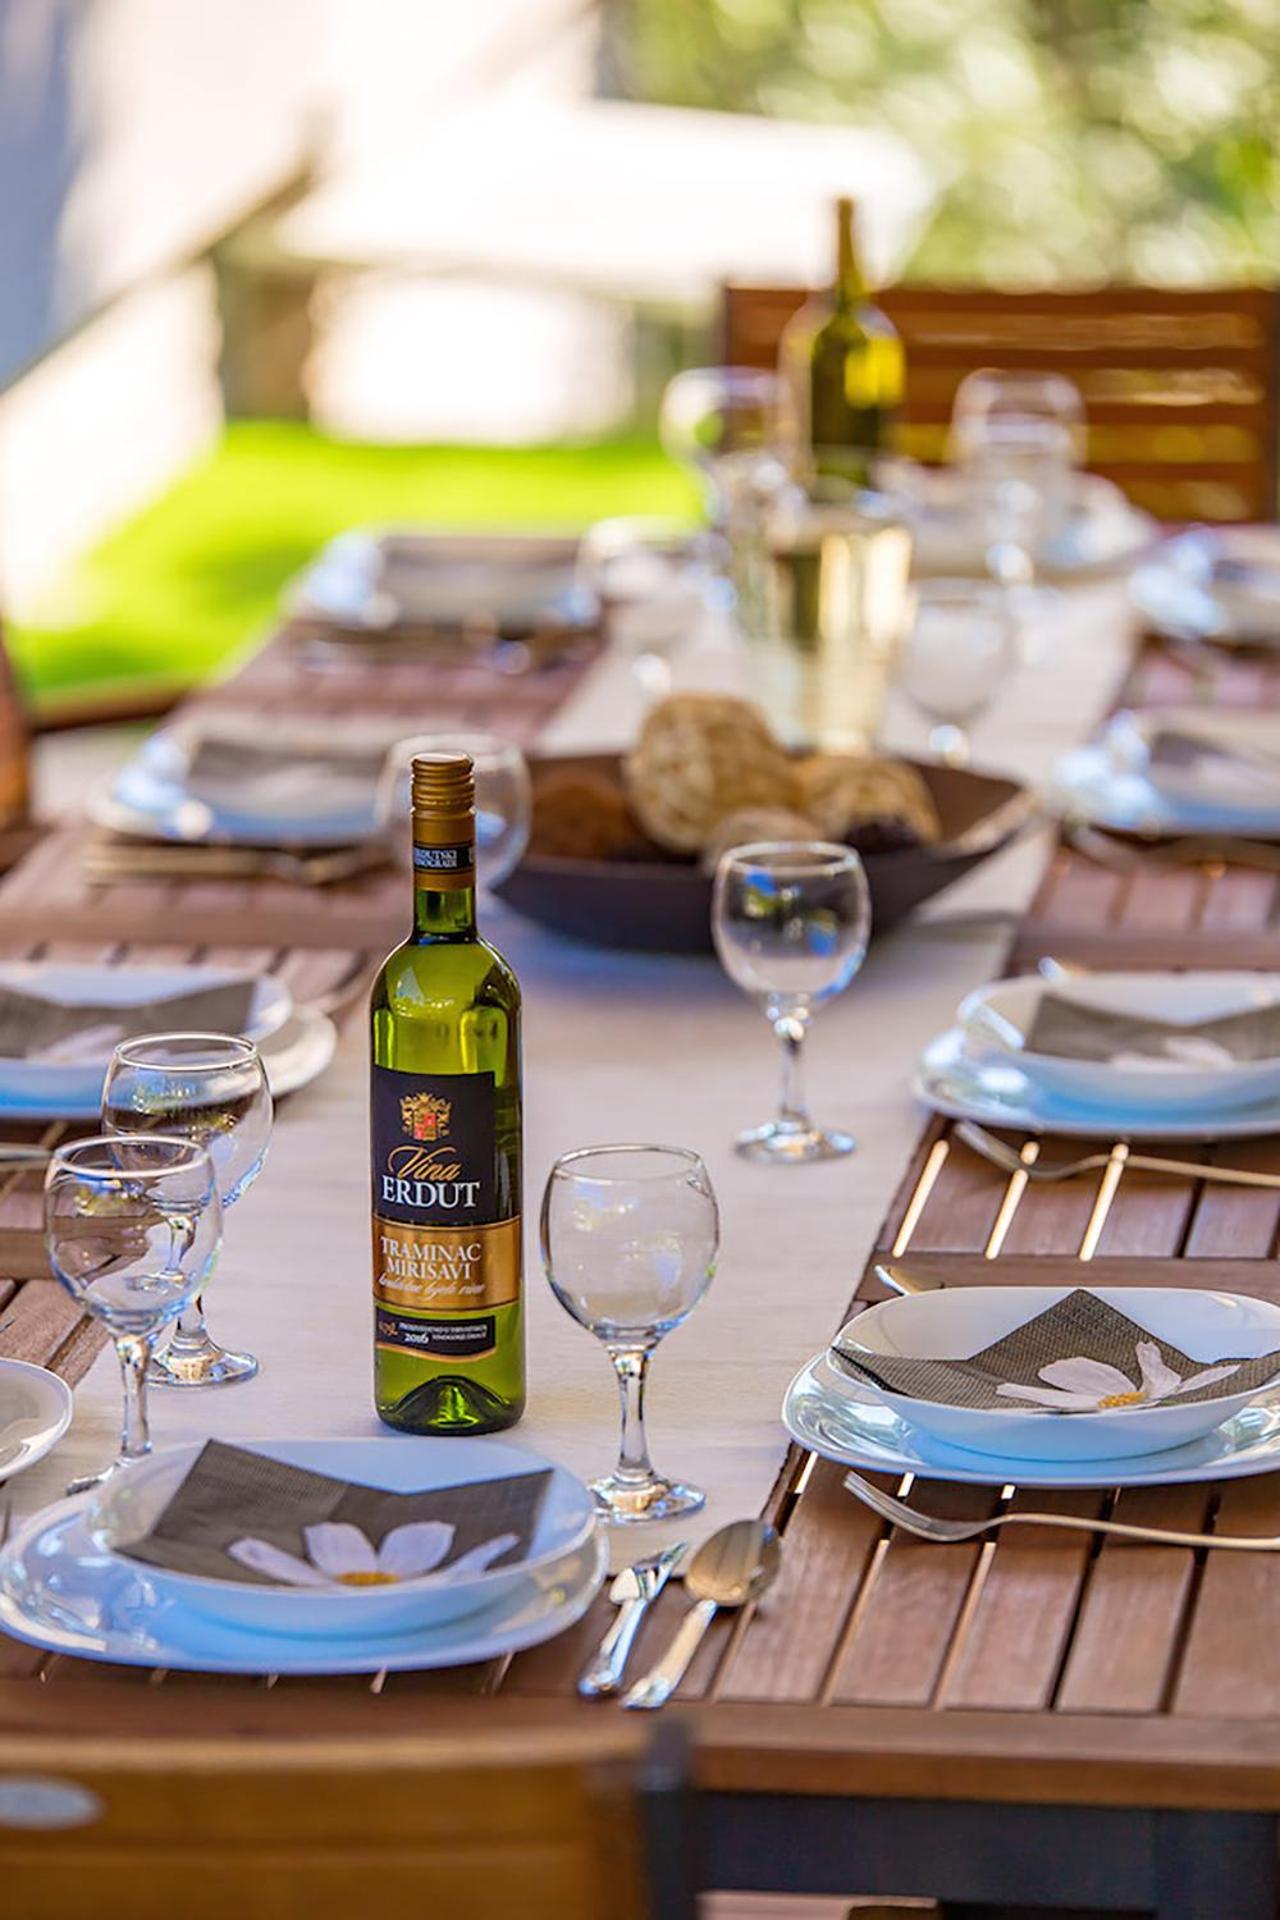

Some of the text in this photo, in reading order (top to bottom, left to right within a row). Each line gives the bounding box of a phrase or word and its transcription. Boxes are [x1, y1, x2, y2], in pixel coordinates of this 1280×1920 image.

[388, 1145, 461, 1180] Vina
[382, 1175, 480, 1209] ERDUT
[380, 1236, 482, 1261] TRAMINAC
[387, 1257, 472, 1280] MIRISAVI
[403, 1332, 429, 1345] 2016
